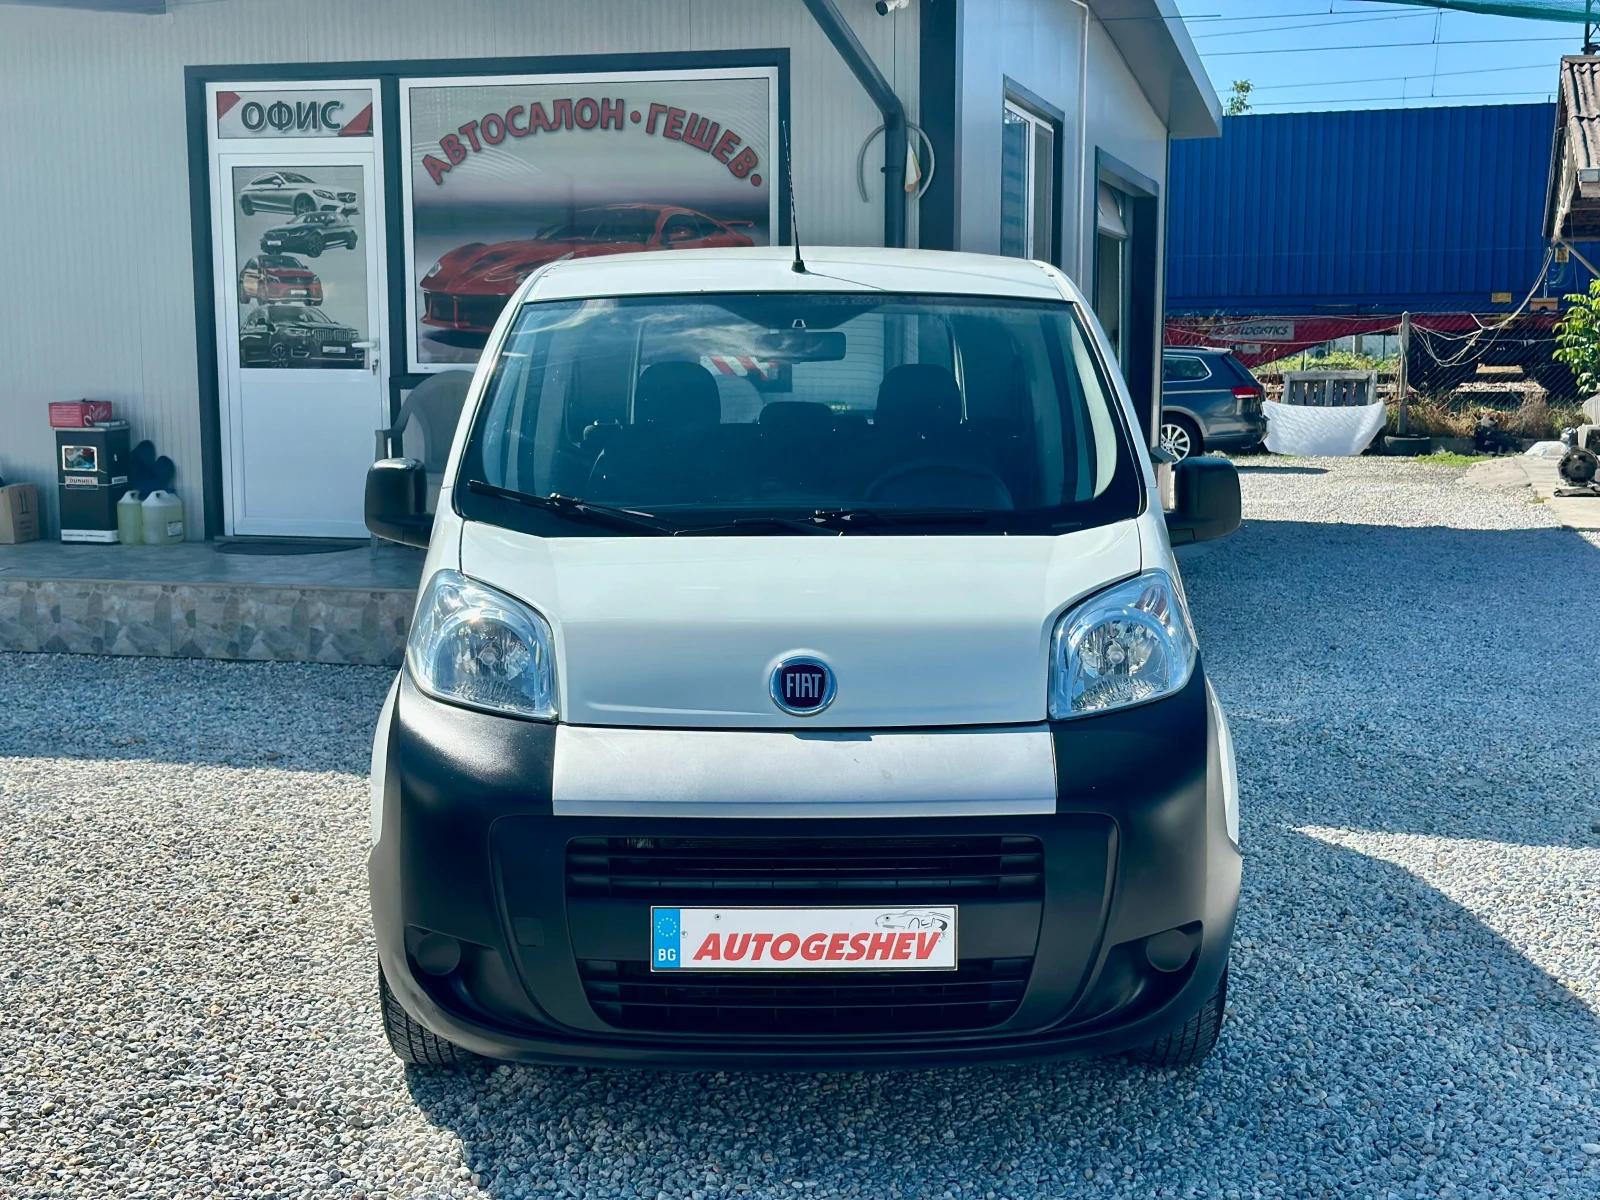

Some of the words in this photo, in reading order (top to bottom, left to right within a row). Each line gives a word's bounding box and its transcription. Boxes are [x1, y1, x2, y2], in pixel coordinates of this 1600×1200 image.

[241, 99, 343, 133] ОФИС
[422, 97, 625, 186] АВТОСАЛОН
[786, 673, 822, 698] FIAT
[658, 949, 677, 962] BG
[692, 931, 942, 962] AUTOGESHEV
